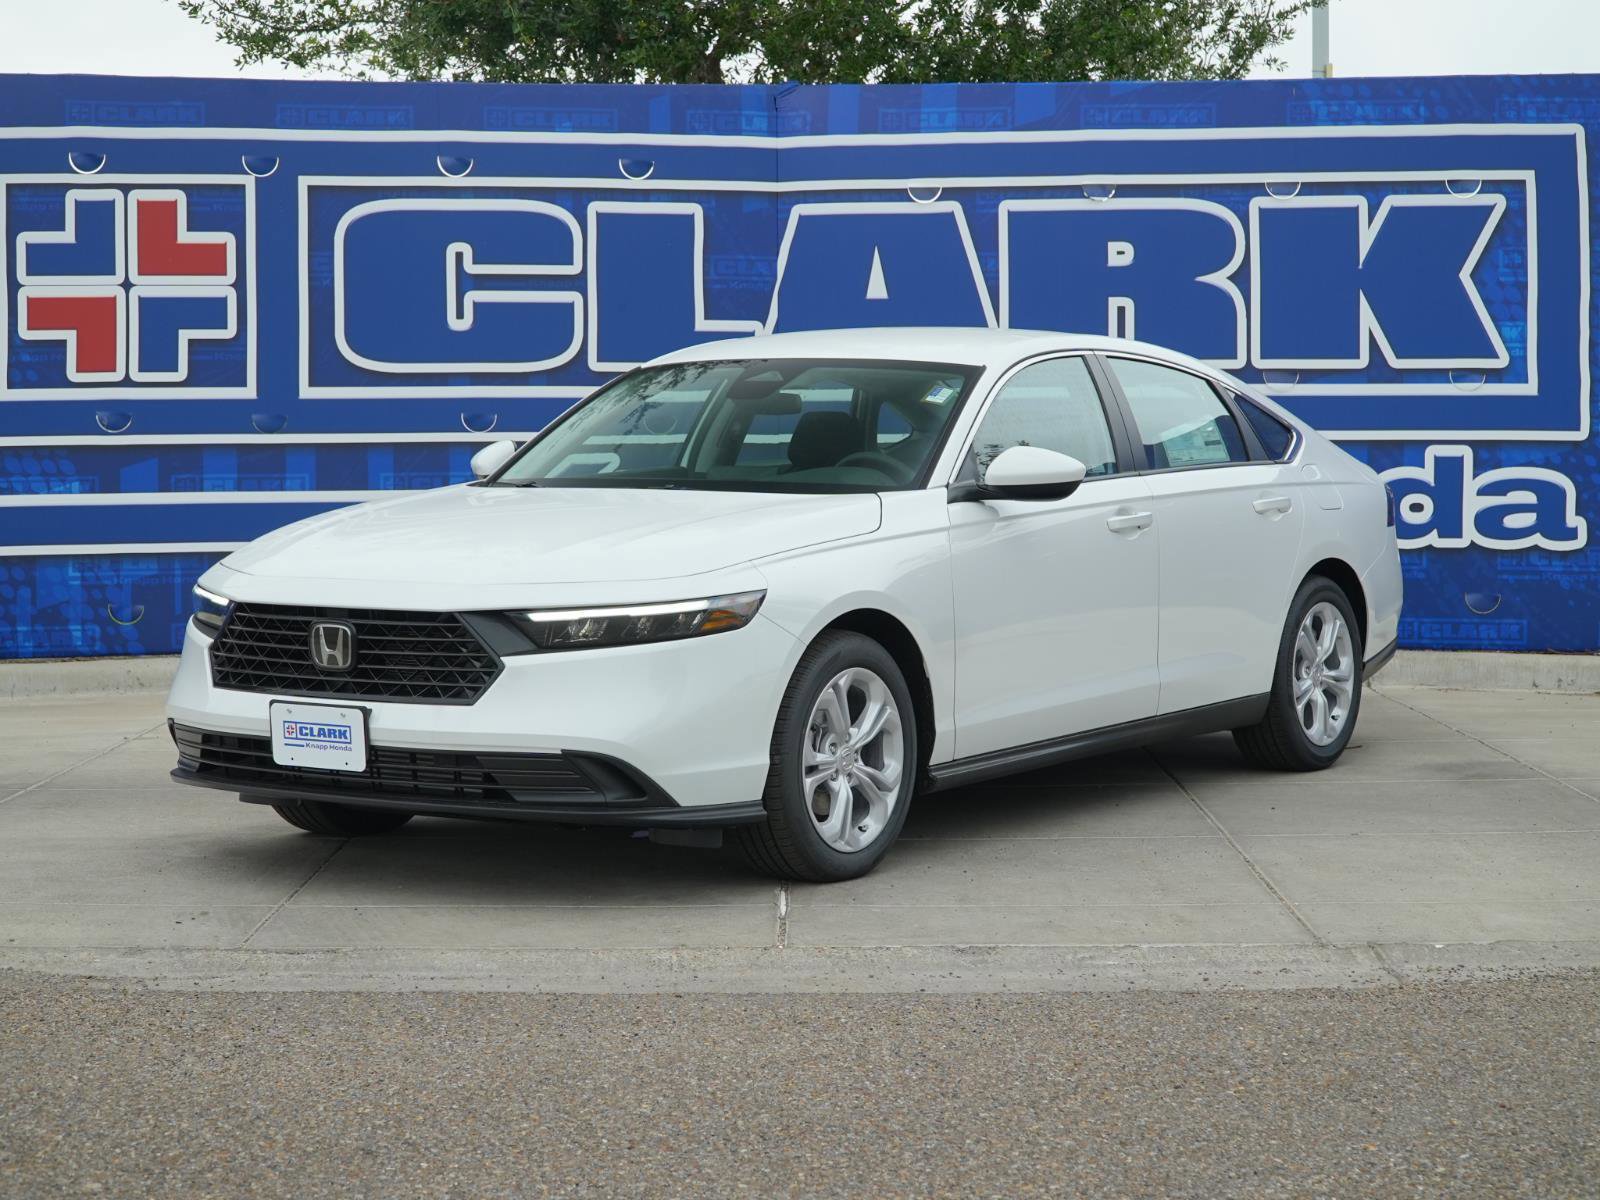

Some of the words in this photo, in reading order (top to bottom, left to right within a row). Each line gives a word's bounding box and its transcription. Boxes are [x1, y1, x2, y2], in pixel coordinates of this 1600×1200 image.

[306, 109, 410, 124] CLARK
[334, 194, 1510, 373] CLARK
[1420, 623, 1521, 640] CLARK
[298, 725, 349, 740] CLARK
[305, 742, 328, 751] Knapp
[329, 744, 353, 752] Honda
